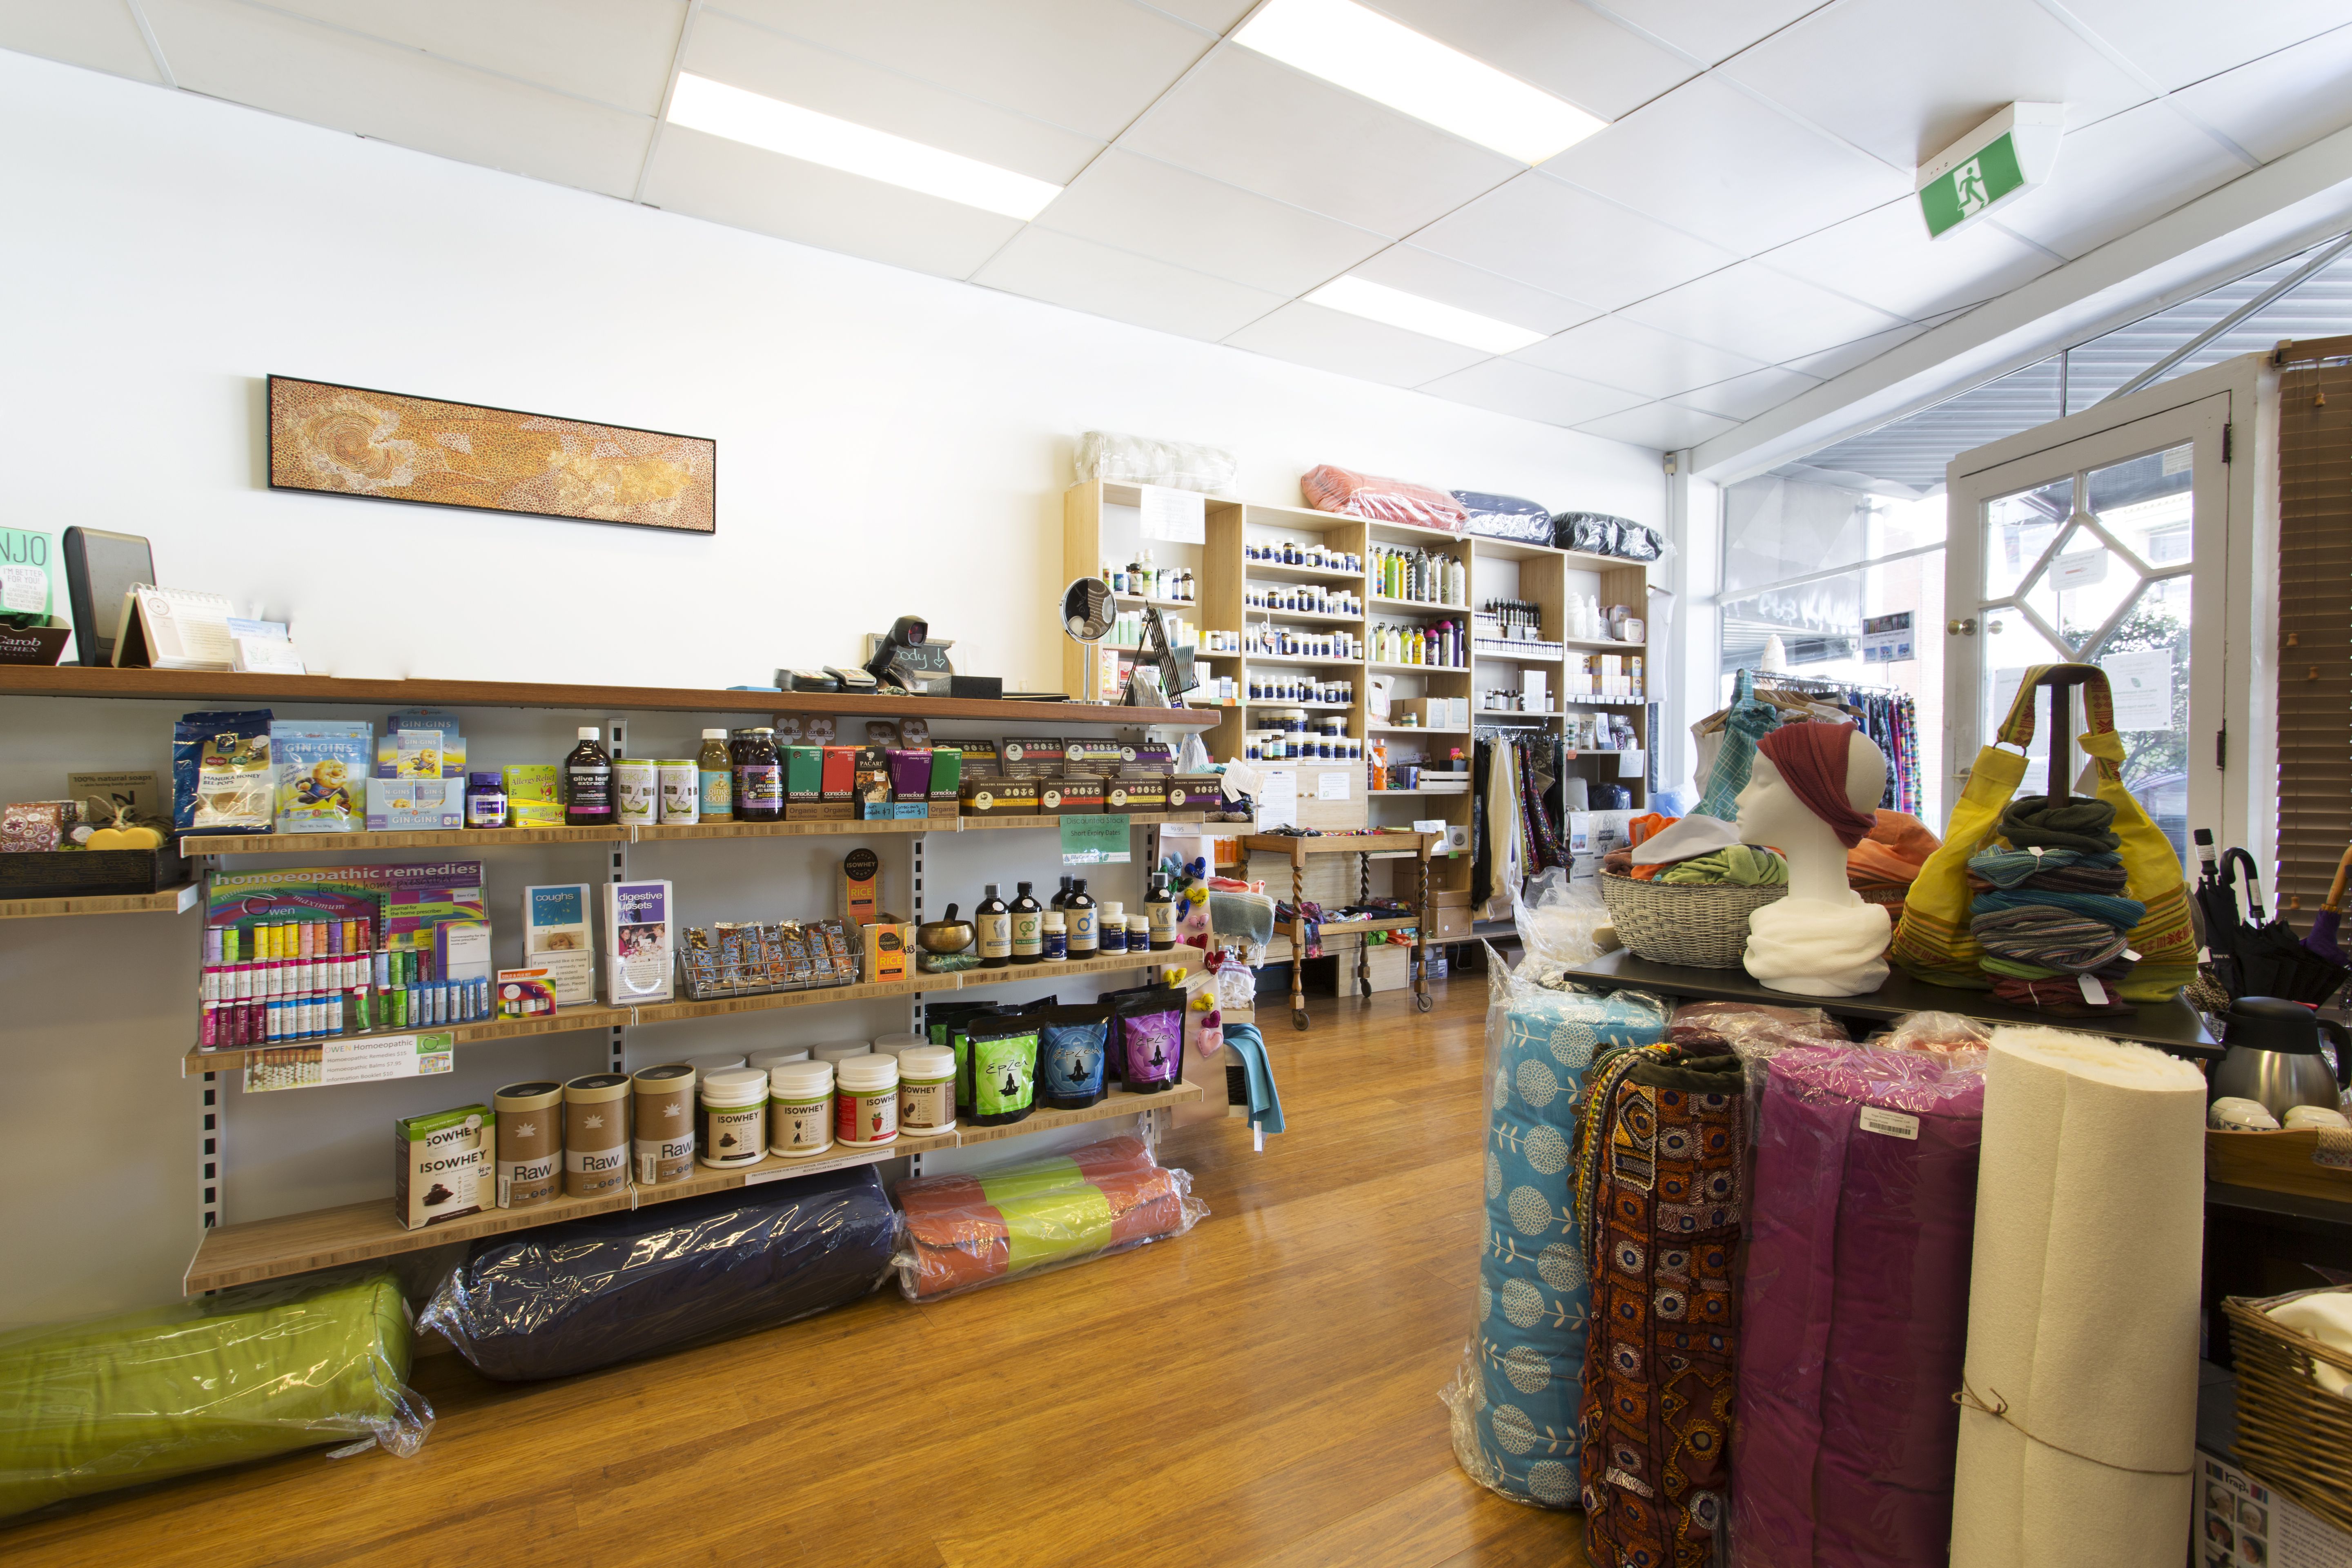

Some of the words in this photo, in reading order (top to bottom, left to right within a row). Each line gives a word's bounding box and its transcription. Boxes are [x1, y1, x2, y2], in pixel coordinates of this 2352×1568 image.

[16, 569, 42, 577] BETTER
[511, 777, 535, 786] Allergy
[536, 773, 555, 782] Relief
[708, 788, 731, 796] ginger
[216, 867, 379, 885] homoeopathic
[385, 864, 477, 877] remedies
[316, 883, 335, 898] for
[340, 883, 359, 893] the
[363, 880, 392, 890] home
[396, 875, 452, 891] prescriber
[220, 885, 272, 901] minimum
[273, 887, 293, 897] dose
[292, 895, 345, 910] maximum
[536, 893, 574, 902] coughs
[619, 892, 663, 902] digestive
[620, 901, 653, 911] upsets
[880, 957, 902, 965] RICE
[325, 1045, 352, 1054] OWEN
[354, 1040, 413, 1051] Homoeopathic
[327, 1054, 368, 1063] Homoeopathic
[327, 1064, 368, 1073] Homoeopathic
[327, 1074, 359, 1083] Information
[902, 1085, 936, 1094] ISOWHEY
[785, 1104, 824, 1114] ISOWHEY
[718, 1111, 759, 1123] ISOWHEY
[662, 1140, 693, 1158] Raw
[420, 1149, 487, 1174] ISOWHEY
[583, 1154, 619, 1171] Raw
[450, 1165, 476, 1173] MANAGEMENT
[514, 1163, 552, 1181] Raw
